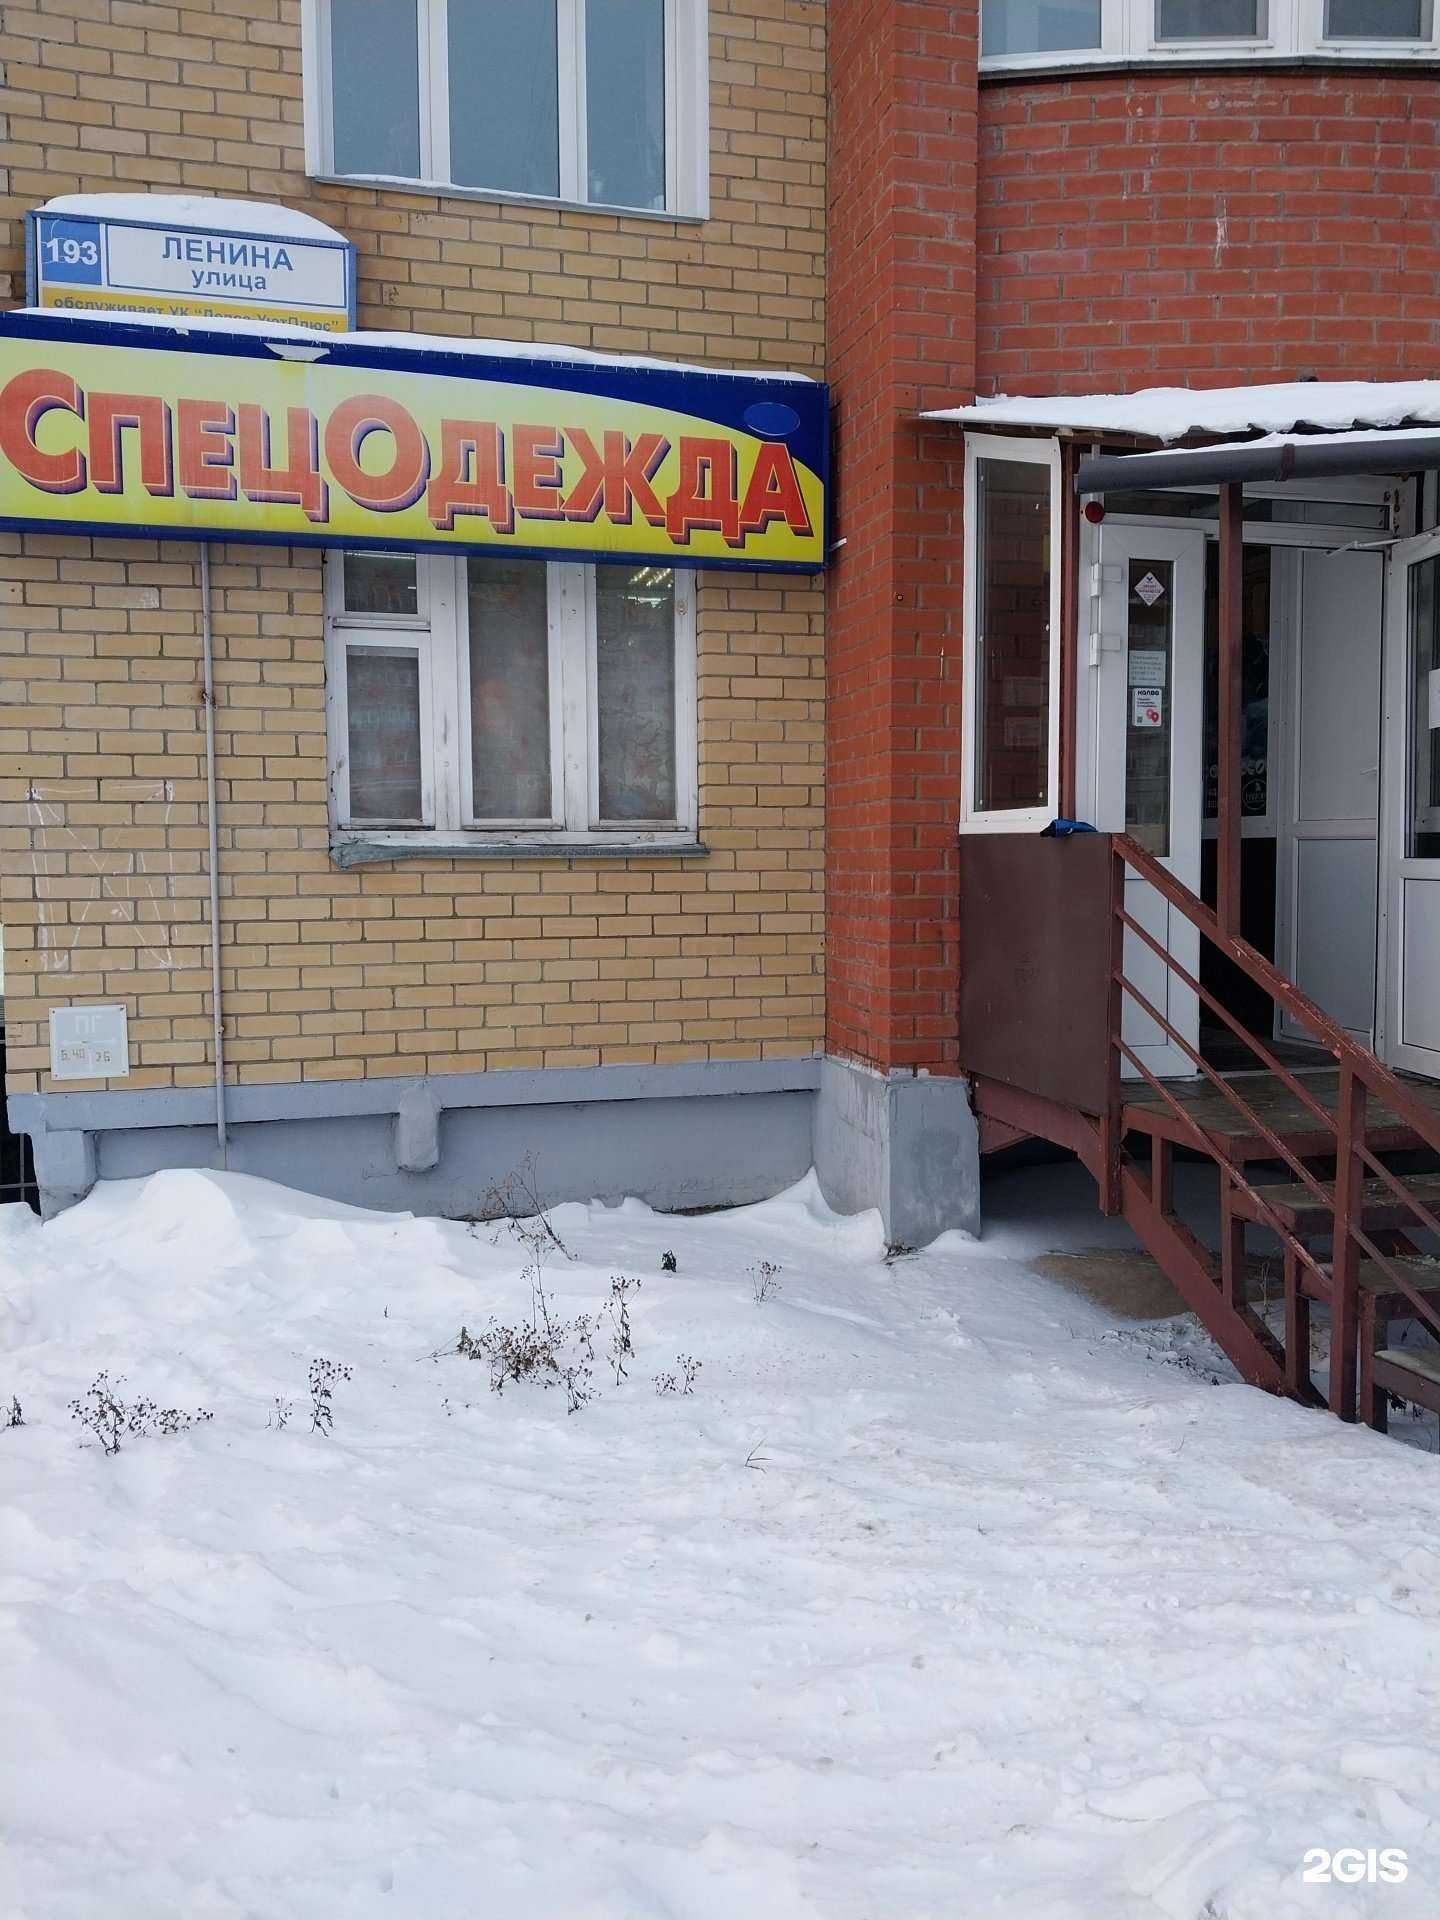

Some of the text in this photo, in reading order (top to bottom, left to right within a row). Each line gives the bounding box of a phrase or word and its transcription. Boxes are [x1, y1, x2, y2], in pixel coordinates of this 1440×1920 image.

[48, 238, 97, 265] 193
[162, 237, 294, 271] ЛЕНИНА
[192, 269, 267, 292] улица
